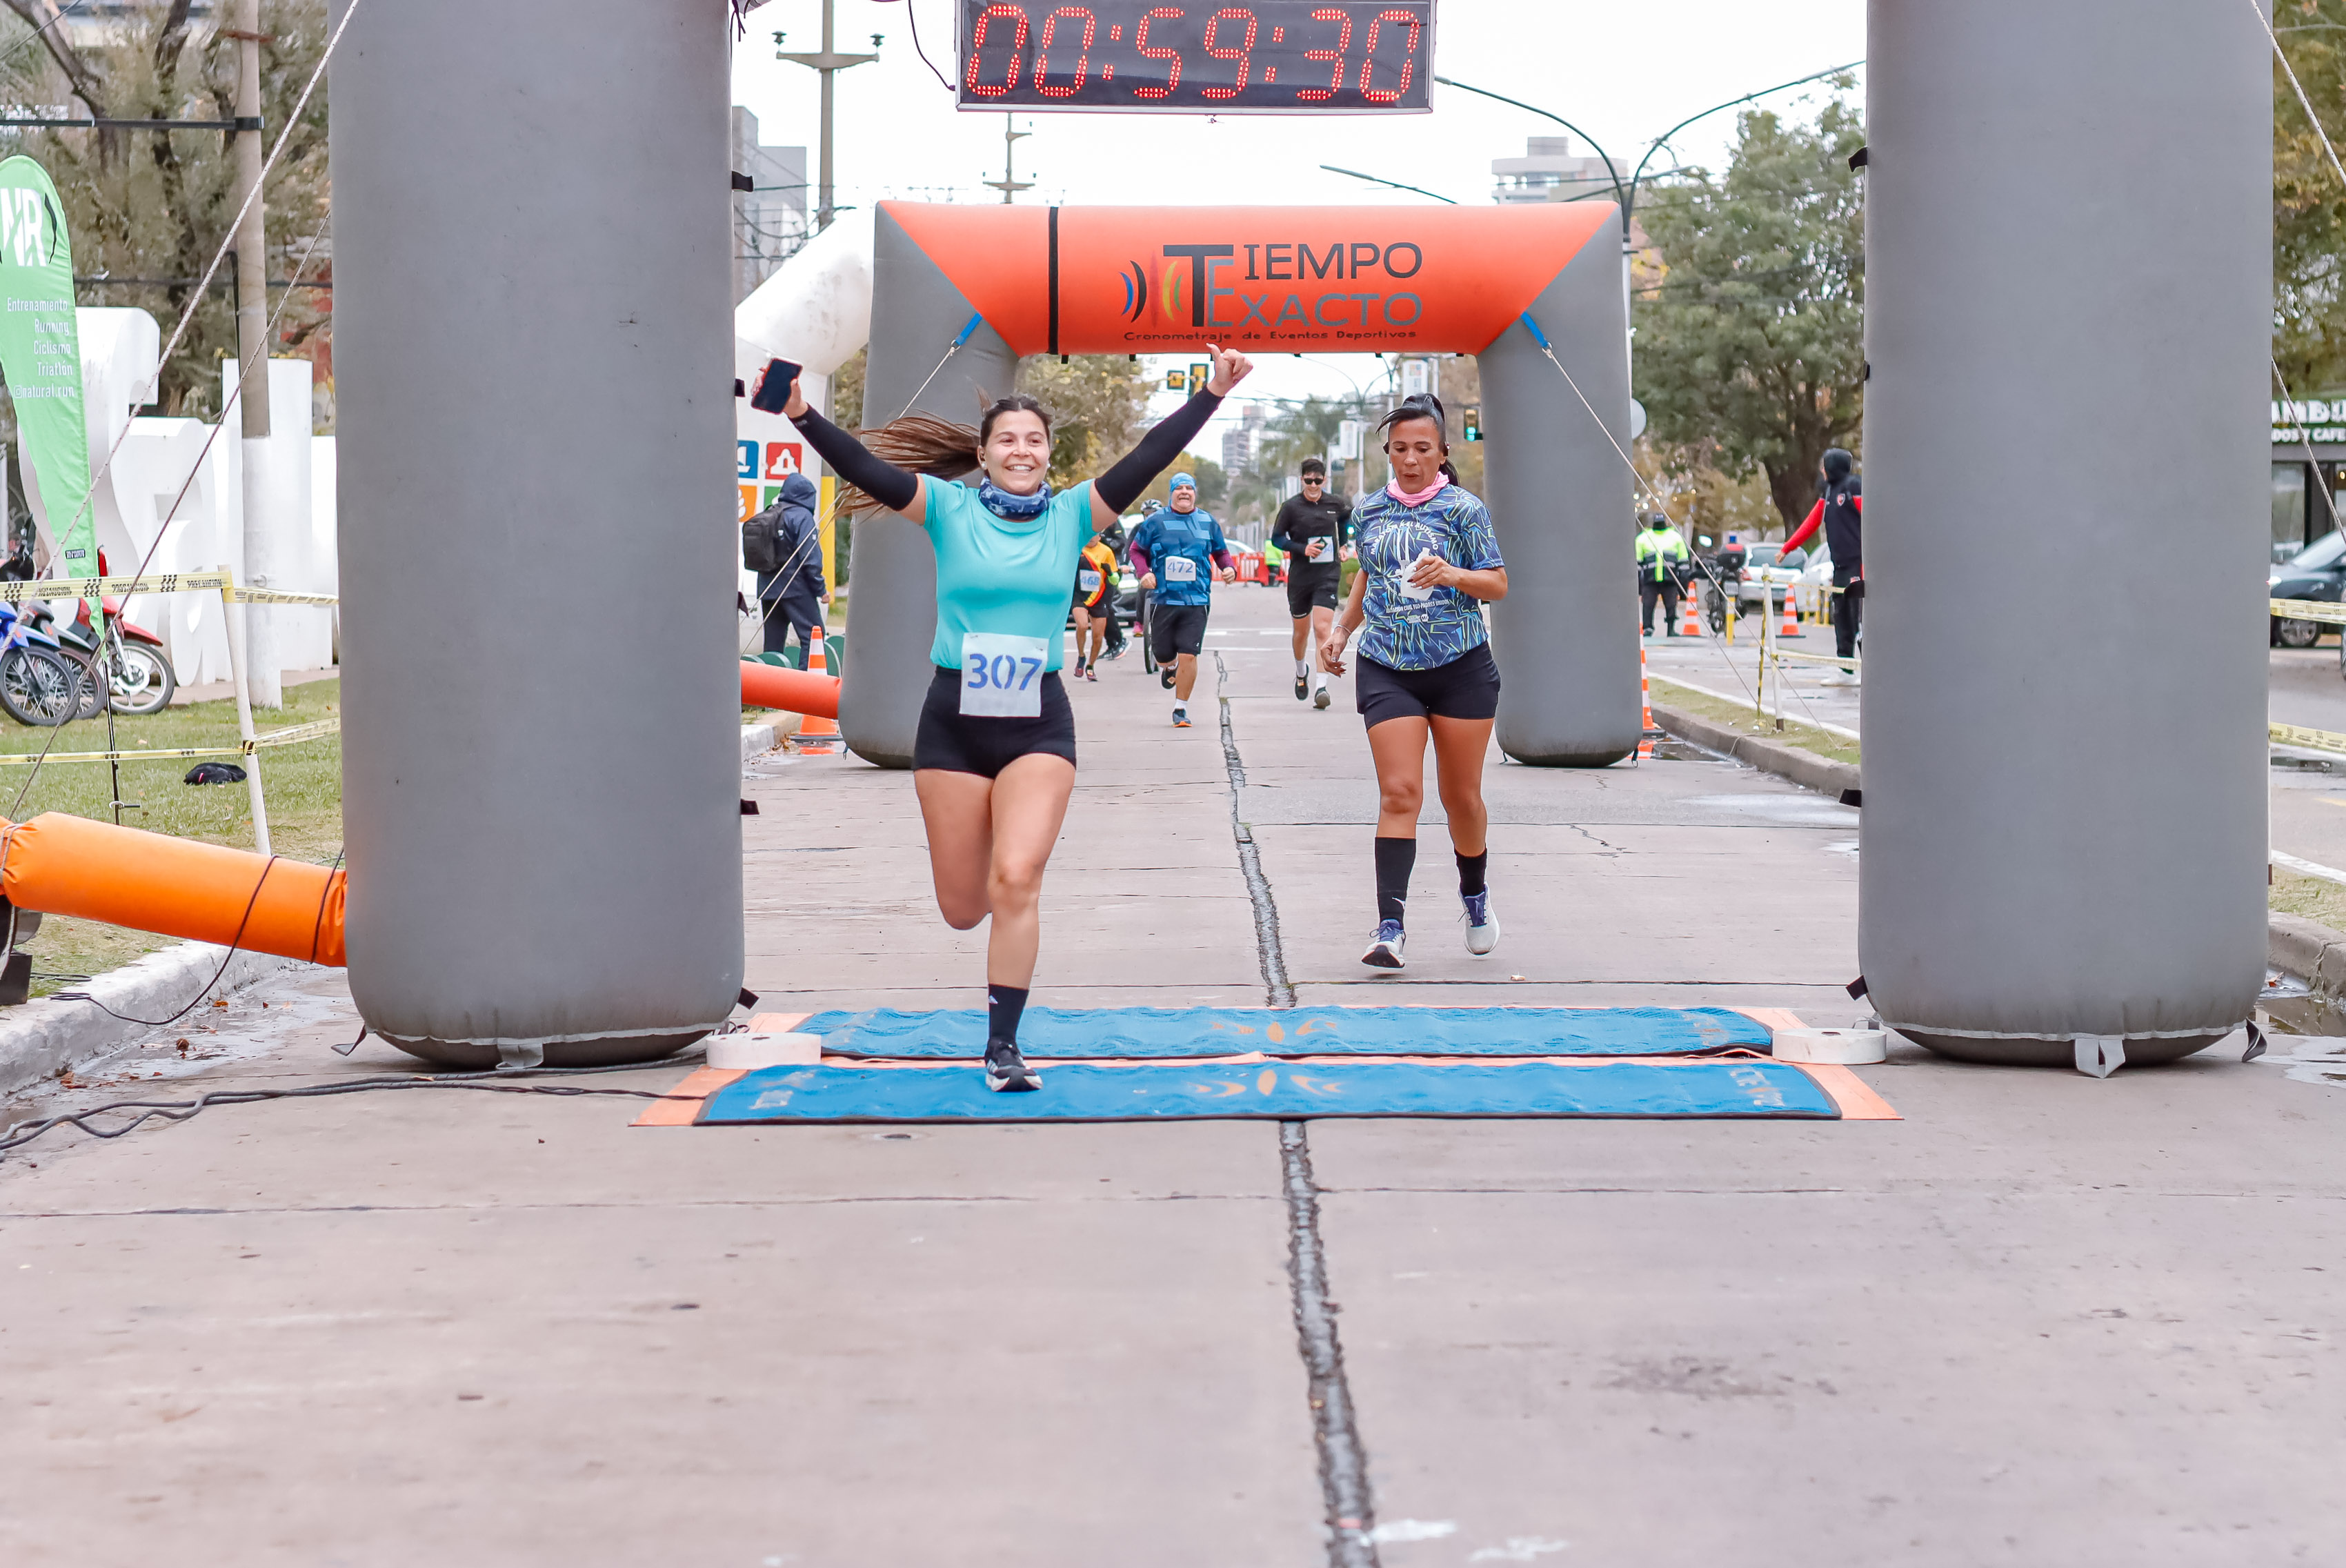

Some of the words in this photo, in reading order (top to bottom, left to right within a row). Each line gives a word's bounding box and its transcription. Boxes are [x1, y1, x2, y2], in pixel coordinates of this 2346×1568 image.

[966, 4, 1420, 101] 00:59:30
[0, 187, 47, 266] NR
[1163, 242, 1422, 327] TIEMPO
[1207, 259, 1422, 327] EXACTO
[7, 297, 68, 312] Entrenamiento
[34, 318, 69, 336] Running
[1124, 332, 1232, 343] Cronometraje
[1242, 331, 1261, 339] de
[1270, 331, 1329, 339] Eventos
[1337, 330, 1416, 339] Deportivos
[34, 339, 71, 355] Ciclismo
[37, 359, 73, 376] Triatlón
[1167, 562, 1193, 573] 472
[967, 653, 1042, 691] 307
